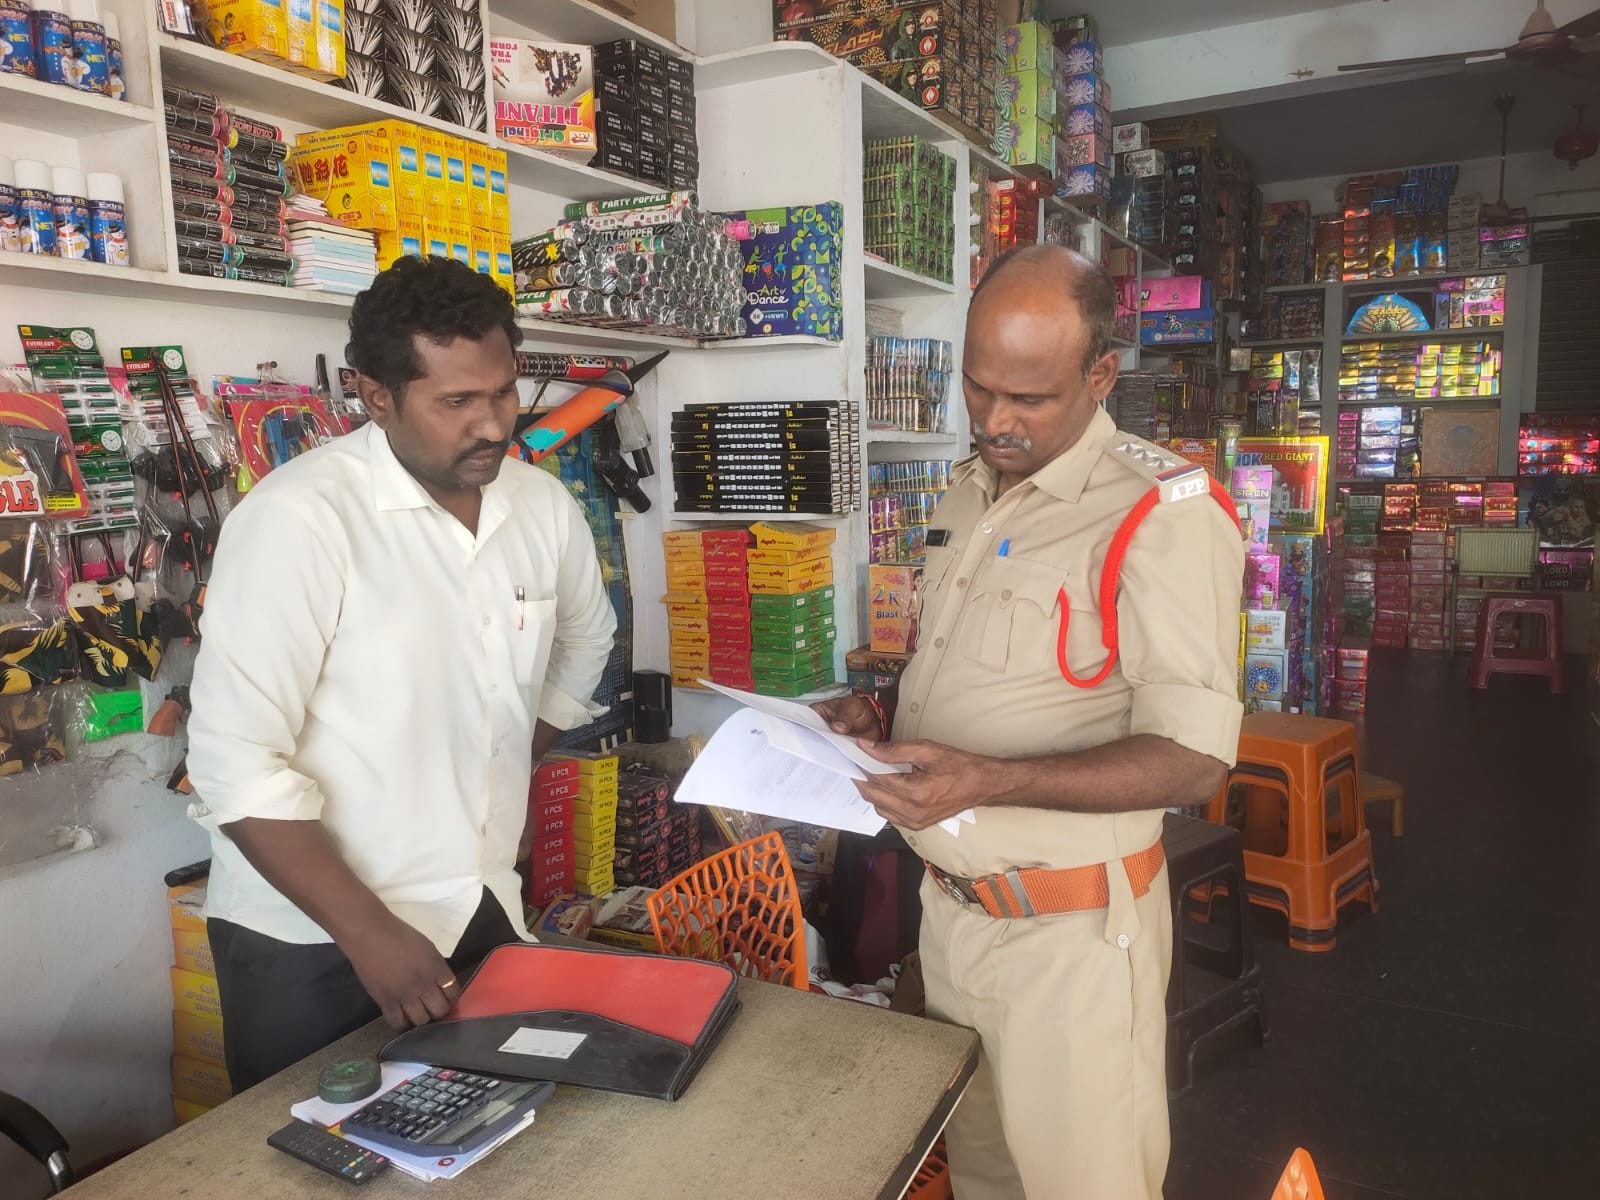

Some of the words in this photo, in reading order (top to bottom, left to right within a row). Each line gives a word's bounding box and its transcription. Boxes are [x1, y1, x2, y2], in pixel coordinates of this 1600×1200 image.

[503, 124, 565, 143] Original
[602, 198, 631, 209] PARTY
[633, 193, 667, 204] POPPER
[618, 226, 654, 239] POPPER
[759, 284, 779, 295] Art
[747, 291, 789, 305] Dance
[1263, 452, 1283, 461] RED
[1285, 452, 1315, 461] GIANT
[1235, 489, 1269, 497] SIREN
[872, 583, 885, 604] 2
[876, 610, 898, 619] Blast
[556, 768, 569, 777] PCS
[555, 786, 568, 794] PCS
[549, 805, 563, 814] PCS
[550, 820, 563, 830] PCS
[549, 839, 563, 848] PCS
[552, 854, 564, 863] PCS
